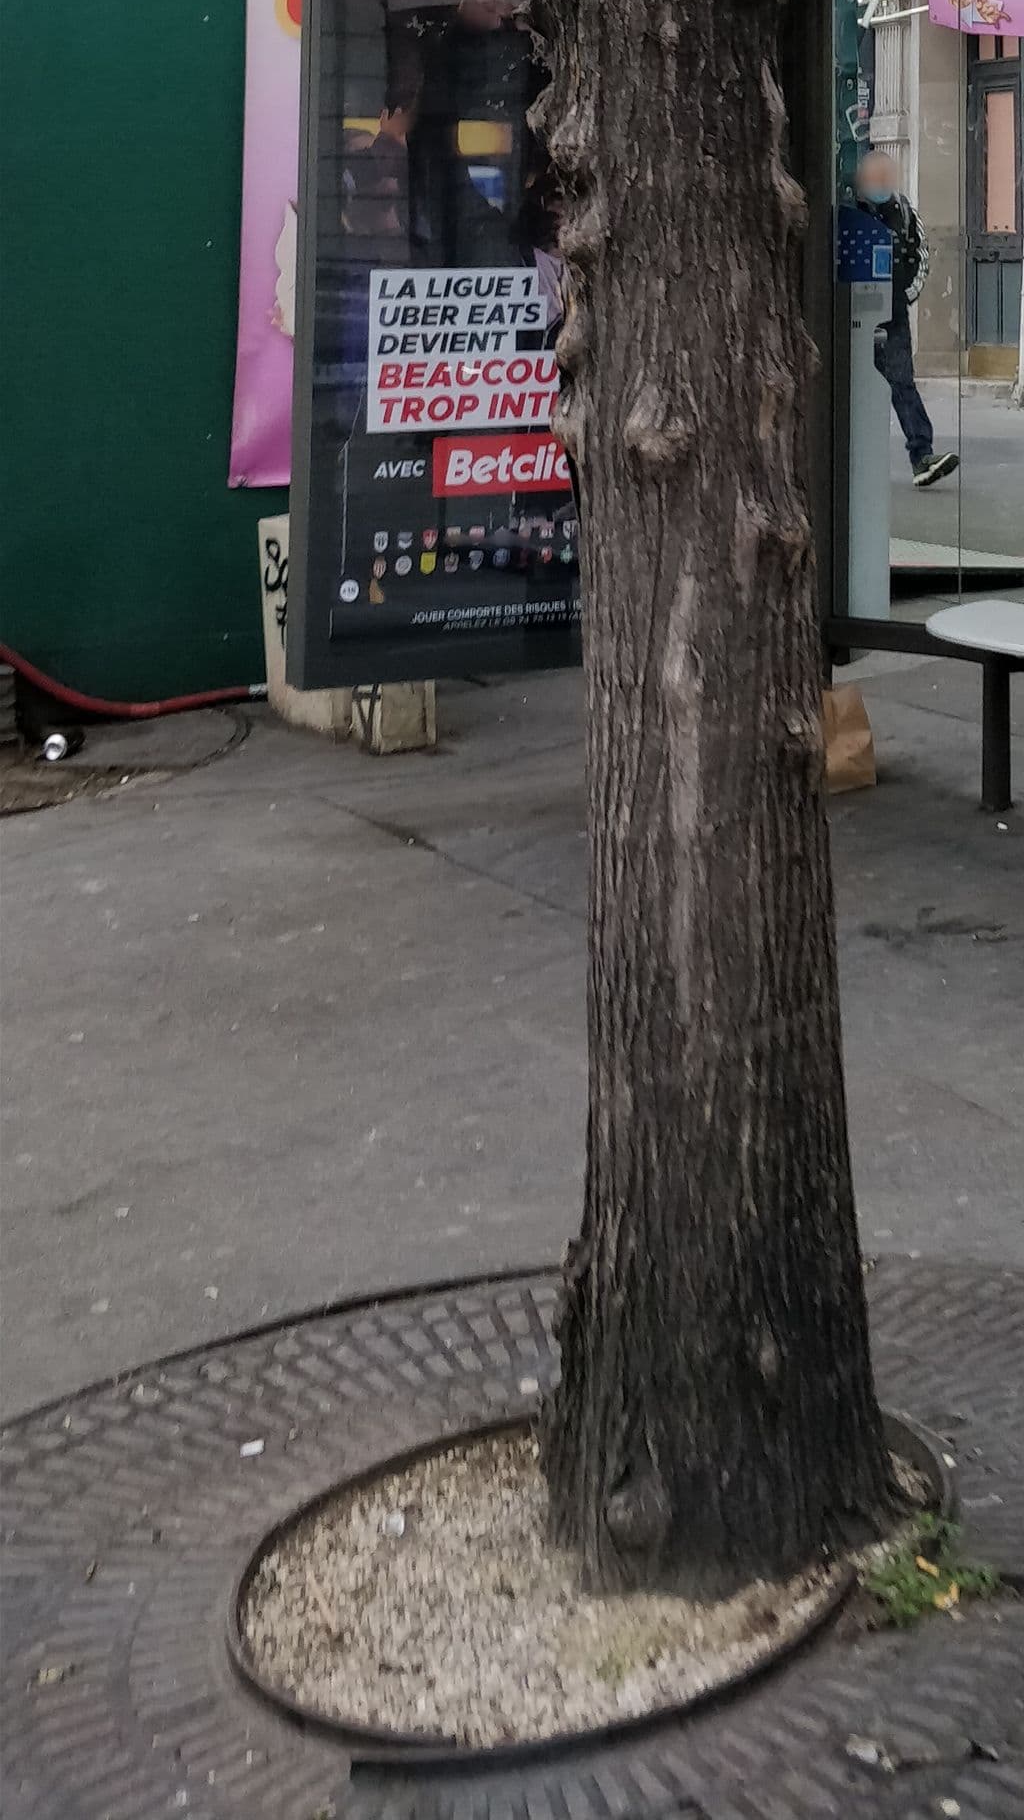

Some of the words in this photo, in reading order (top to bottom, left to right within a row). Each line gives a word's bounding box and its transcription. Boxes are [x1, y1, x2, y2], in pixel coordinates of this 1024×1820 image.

[378, 277, 417, 300] LA
[426, 275, 514, 300] LIGUE
[521, 275, 534, 296] 1
[379, 305, 460, 328] UBER
[467, 302, 541, 325] EATS
[377, 329, 508, 356] DEVIENT
[379, 393, 480, 424] TROP
[373, 459, 427, 480] AVEC
[411, 609, 446, 624] JOUER
[447, 604, 502, 621] COMPORTE
[504, 603, 524, 617] DES
